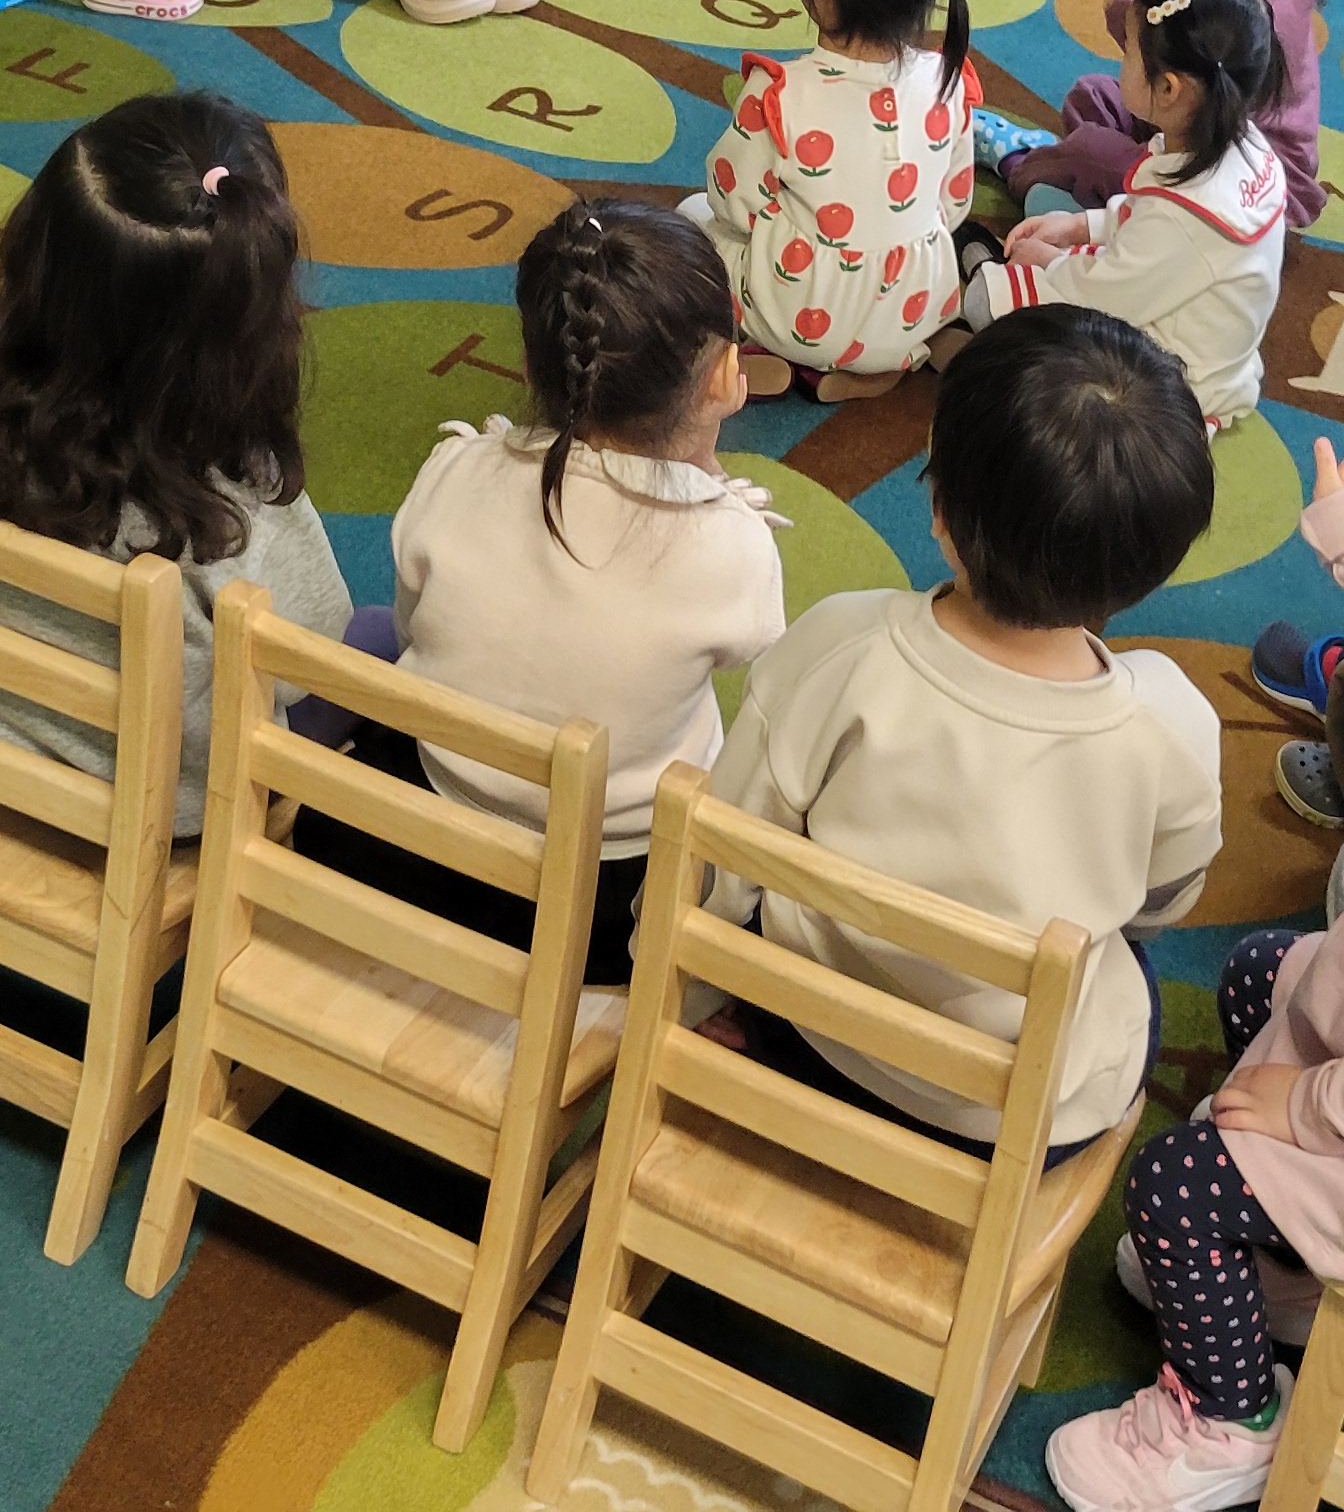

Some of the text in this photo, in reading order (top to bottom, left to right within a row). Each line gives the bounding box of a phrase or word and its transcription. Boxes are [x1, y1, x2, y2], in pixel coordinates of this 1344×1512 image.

[135, 3, 189, 19] crocs
[5, 46, 91, 96] F
[486, 86, 604, 133] R
[404, 188, 514, 241] S
[427, 334, 527, 384] T
